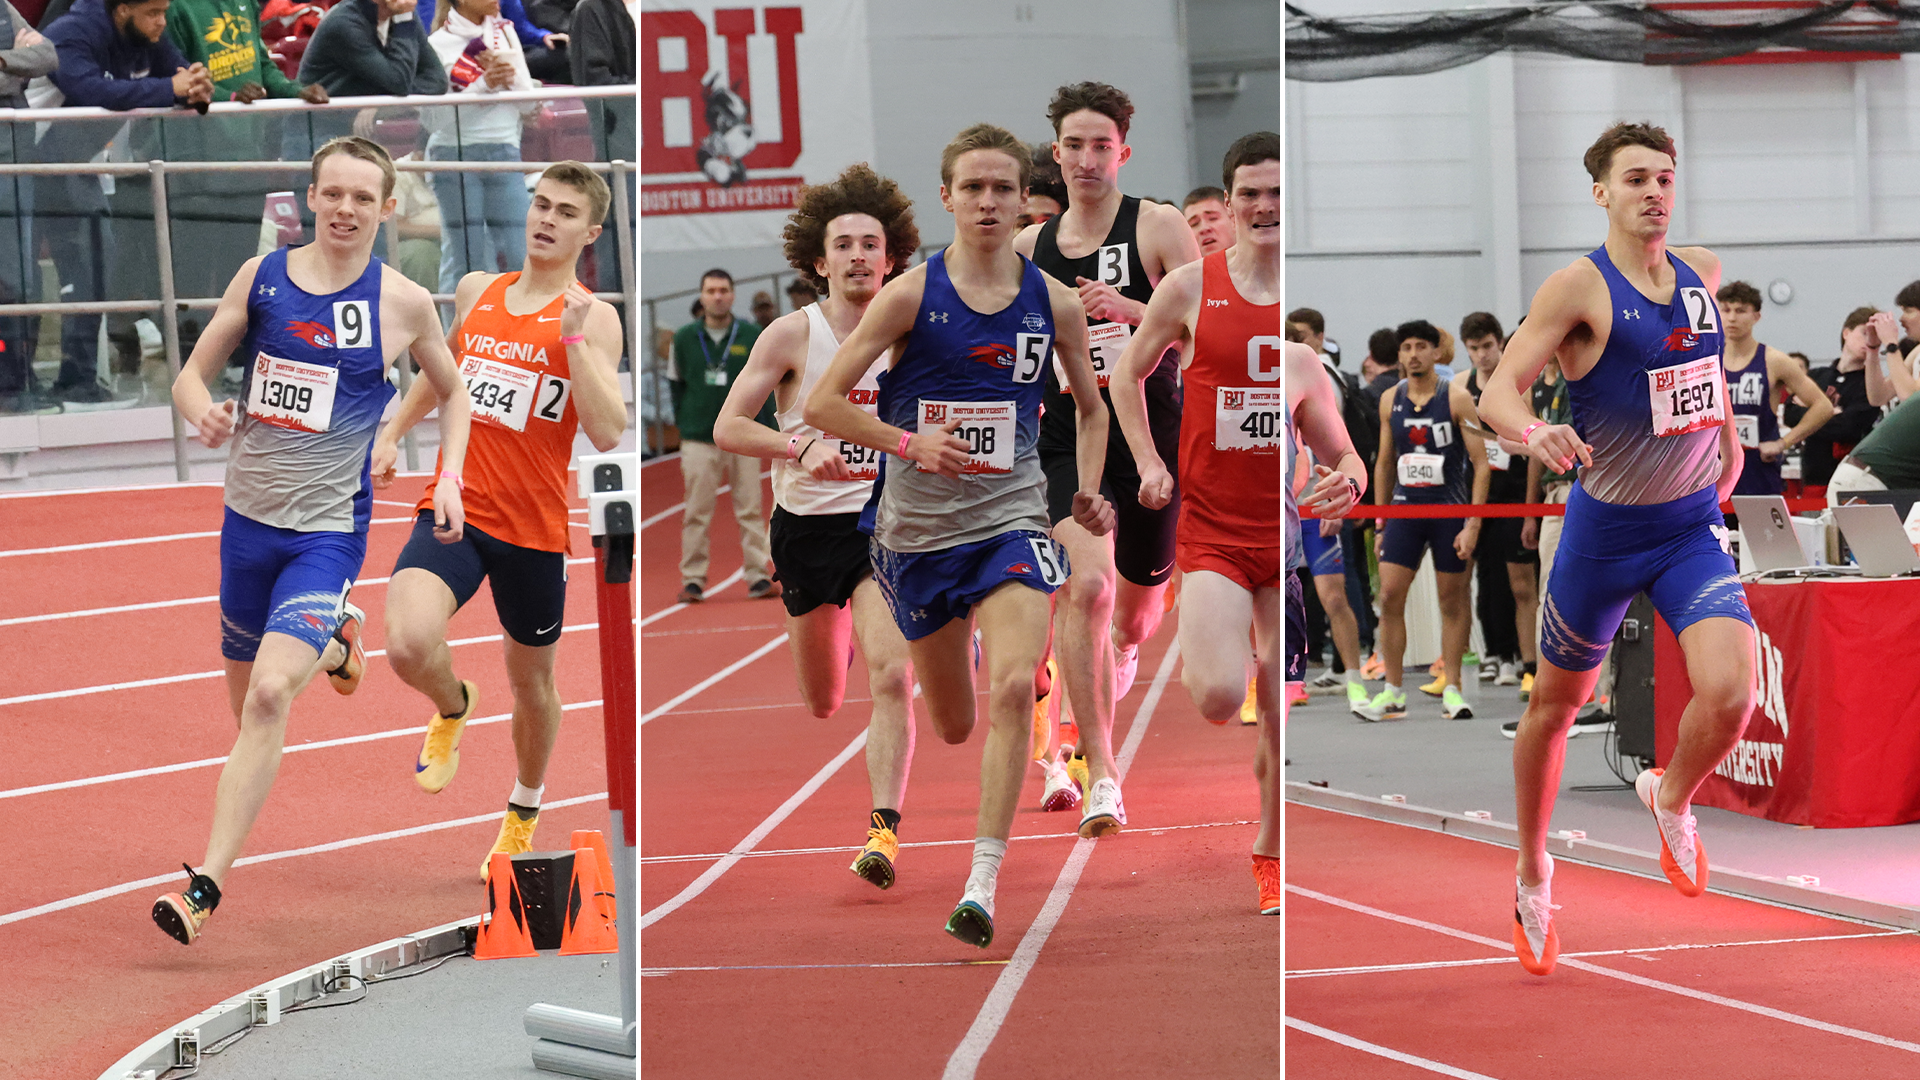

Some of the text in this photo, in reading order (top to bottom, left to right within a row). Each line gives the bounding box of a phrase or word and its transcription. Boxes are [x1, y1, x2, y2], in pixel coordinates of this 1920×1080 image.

[641, 7, 804, 174] BU
[706, 185, 800, 208] UNIVERSITY
[1105, 247, 1123, 286] 3
[341, 303, 362, 346] 9
[1689, 289, 1714, 331] 2
[464, 332, 550, 367] VIRGINIA
[1021, 336, 1044, 381] 5
[1247, 335, 1280, 382] C
[260, 379, 313, 414] 1309
[1655, 369, 1675, 389] BU
[1743, 378, 1754, 398] 4
[540, 379, 565, 420] 2
[925, 404, 947, 421] BU
[975, 407, 1009, 415] UNIVERSITY
[1223, 391, 1246, 406] BU
[1671, 381, 1715, 417] 1297
[1438, 425, 1449, 444] 1
[1407, 465, 1434, 479] 1240
[1035, 541, 1058, 583] 5
